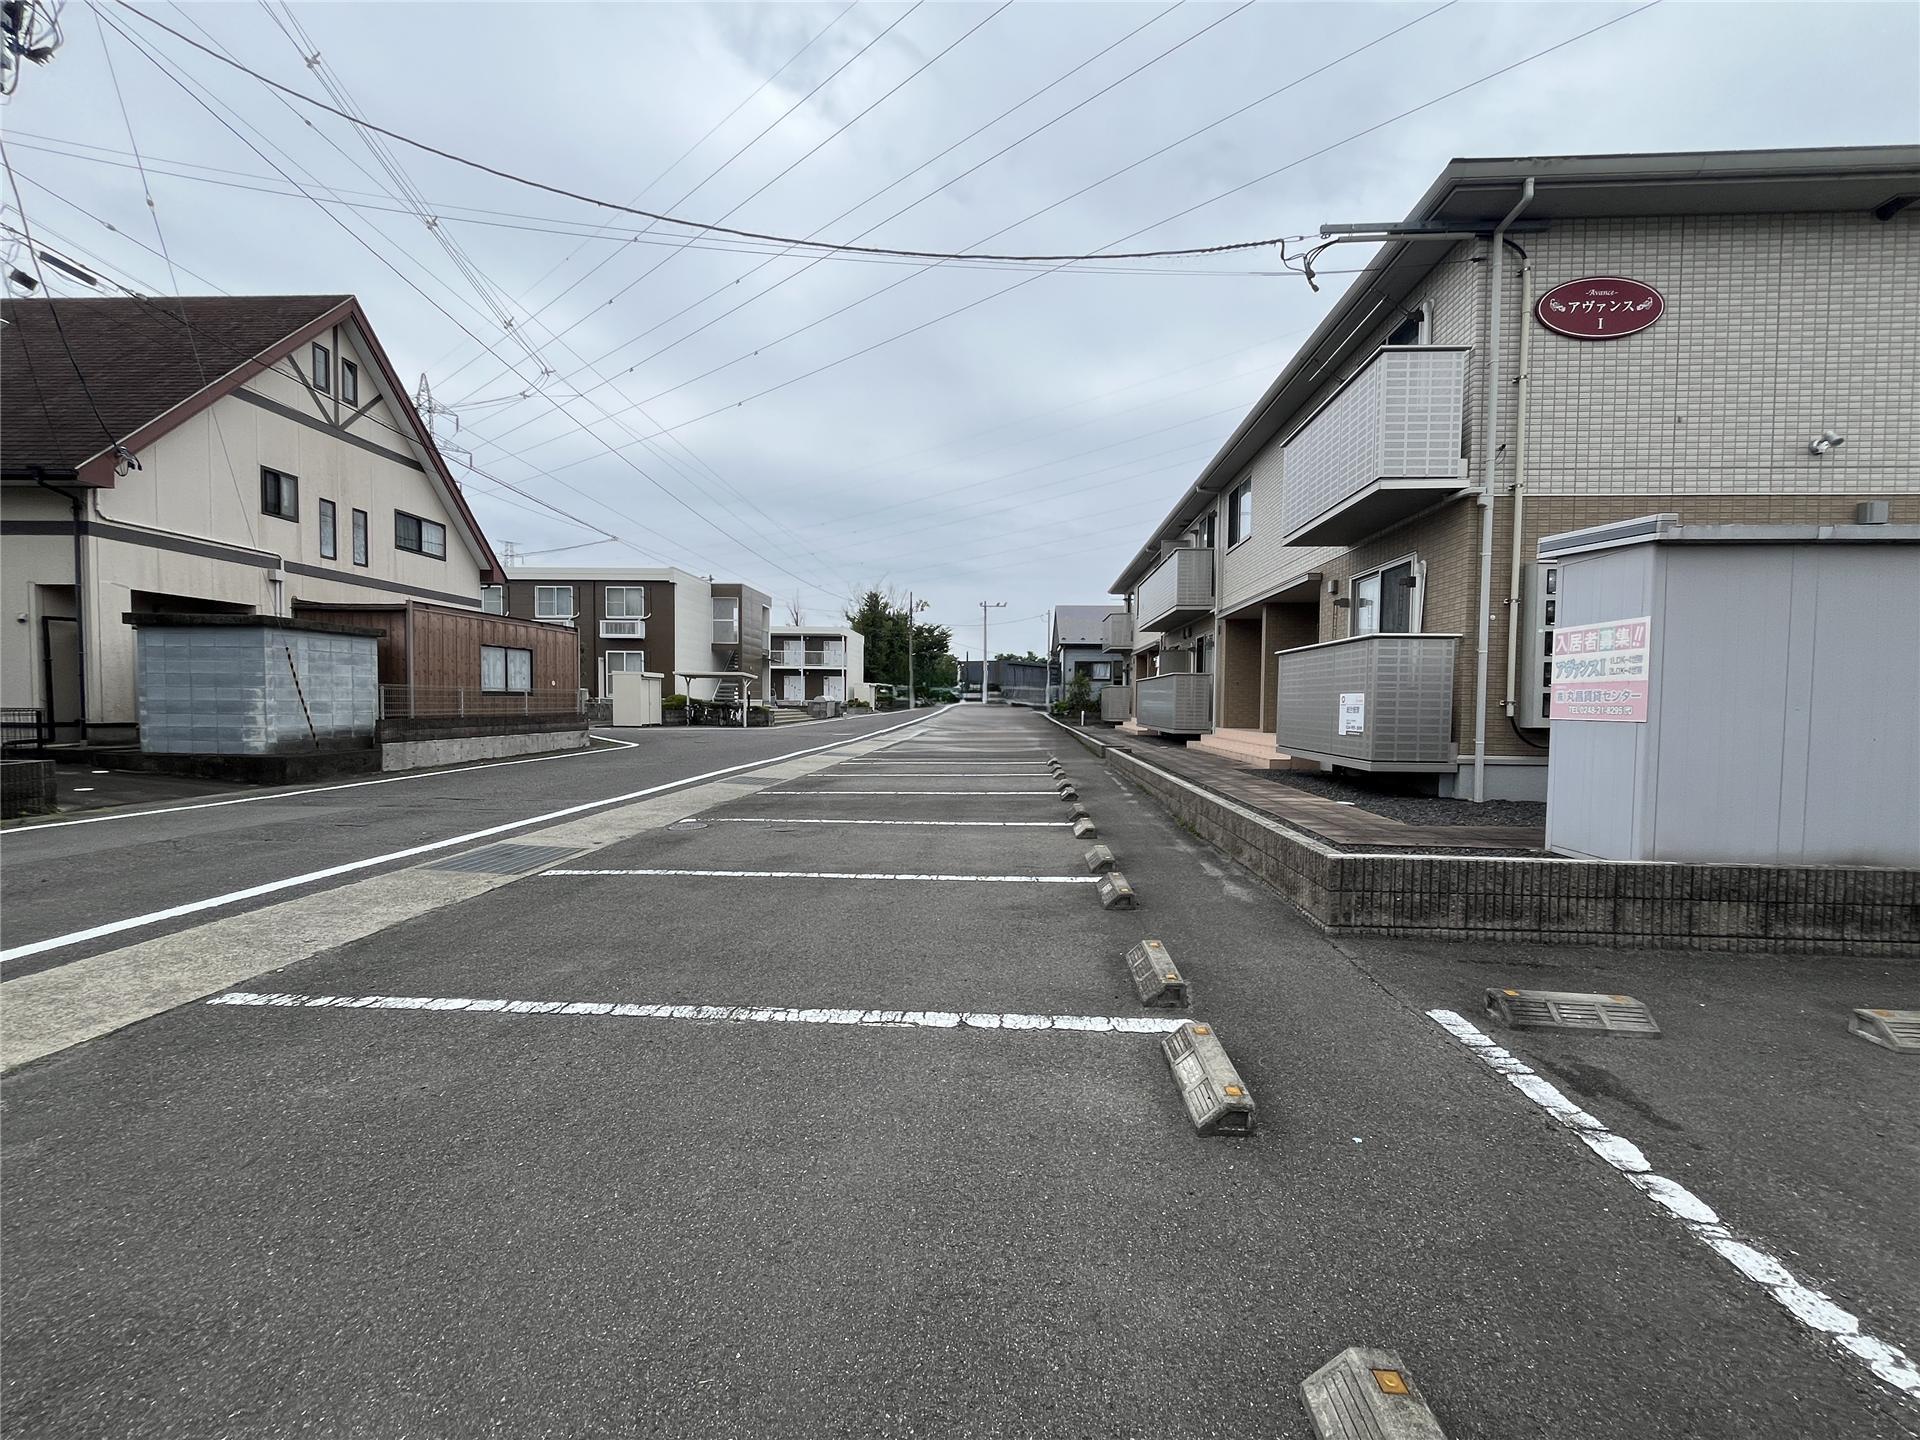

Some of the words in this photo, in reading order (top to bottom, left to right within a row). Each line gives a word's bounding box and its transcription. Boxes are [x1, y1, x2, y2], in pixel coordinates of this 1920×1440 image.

[1568, 300, 1635, 314] アヴァンス
